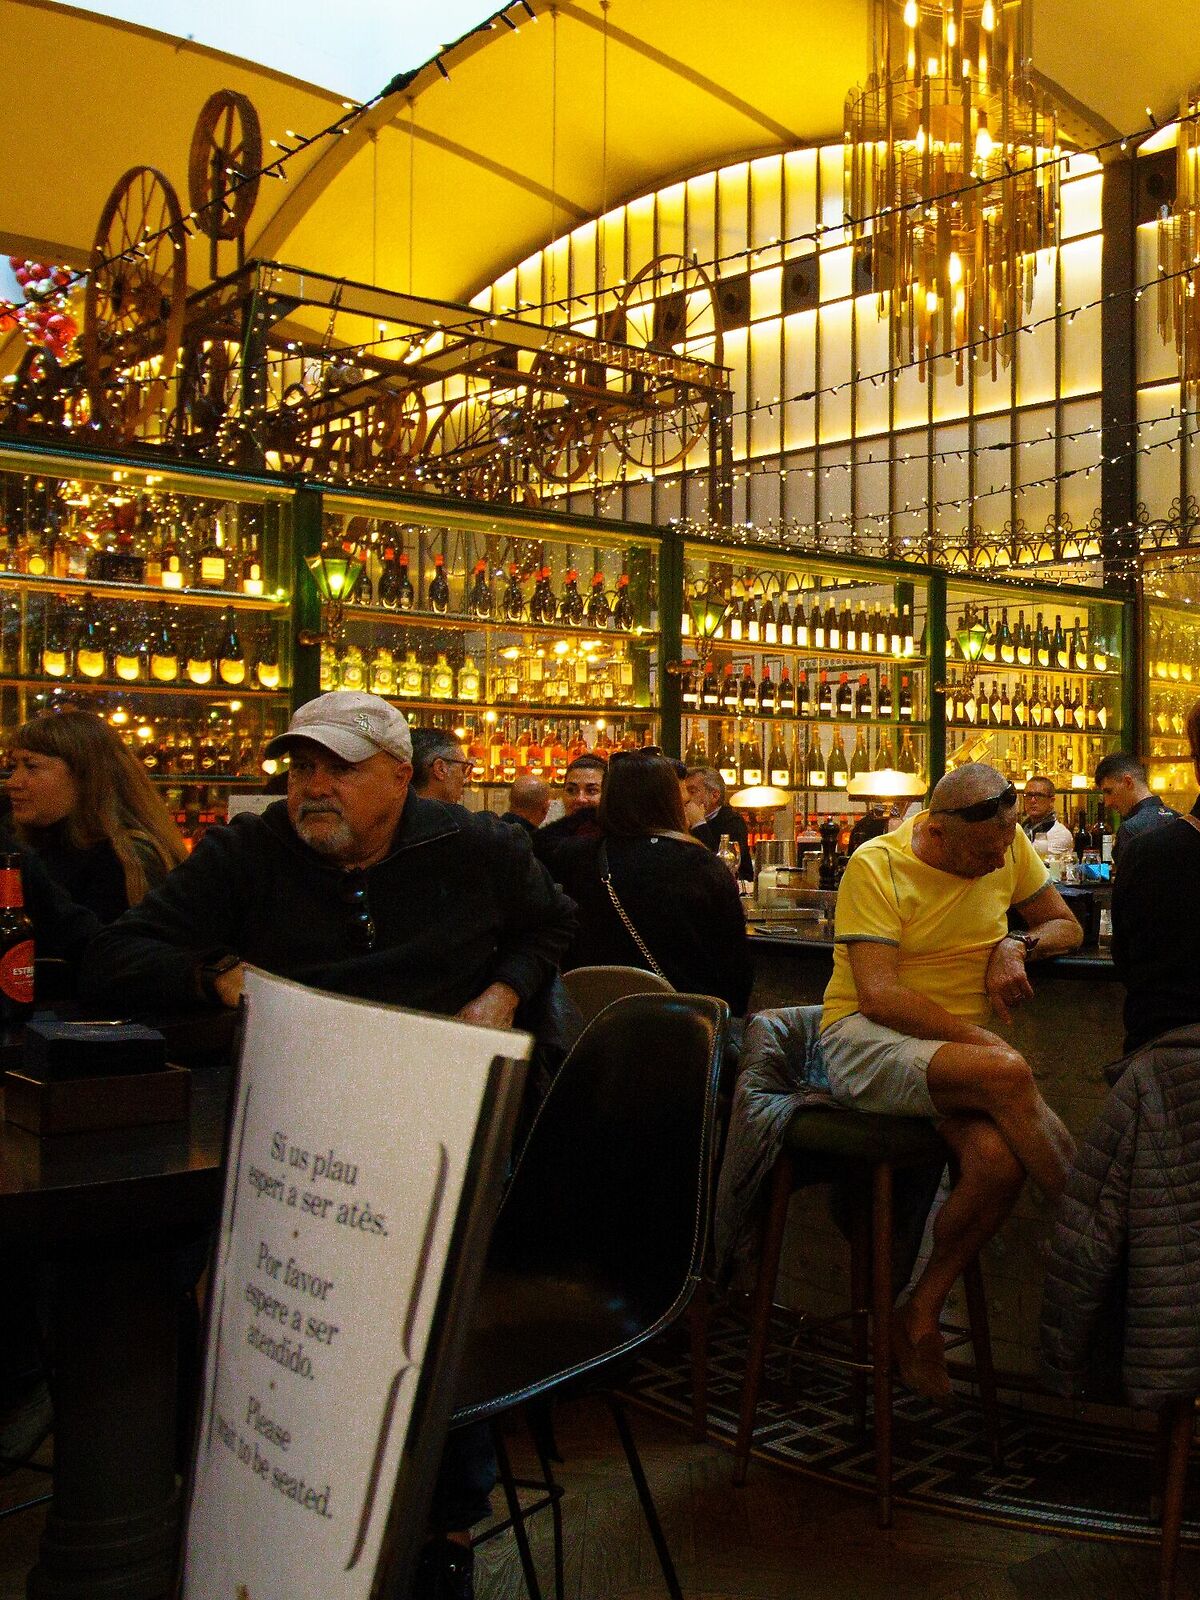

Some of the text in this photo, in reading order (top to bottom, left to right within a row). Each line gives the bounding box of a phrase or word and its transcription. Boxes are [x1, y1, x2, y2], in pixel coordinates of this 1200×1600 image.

[271, 1131, 358, 1186] Si us plau
[249, 1165, 388, 1236] esperi a ser atès.
[257, 1242, 334, 1301] Por favor
[245, 1284, 339, 1345] espere a ser
[246, 1325, 314, 1381] atendido.
[245, 1395, 291, 1453] Please
[238, 1435, 251, 1466] to
[252, 1441, 270, 1480] be
[271, 1466, 333, 1519] seated.
